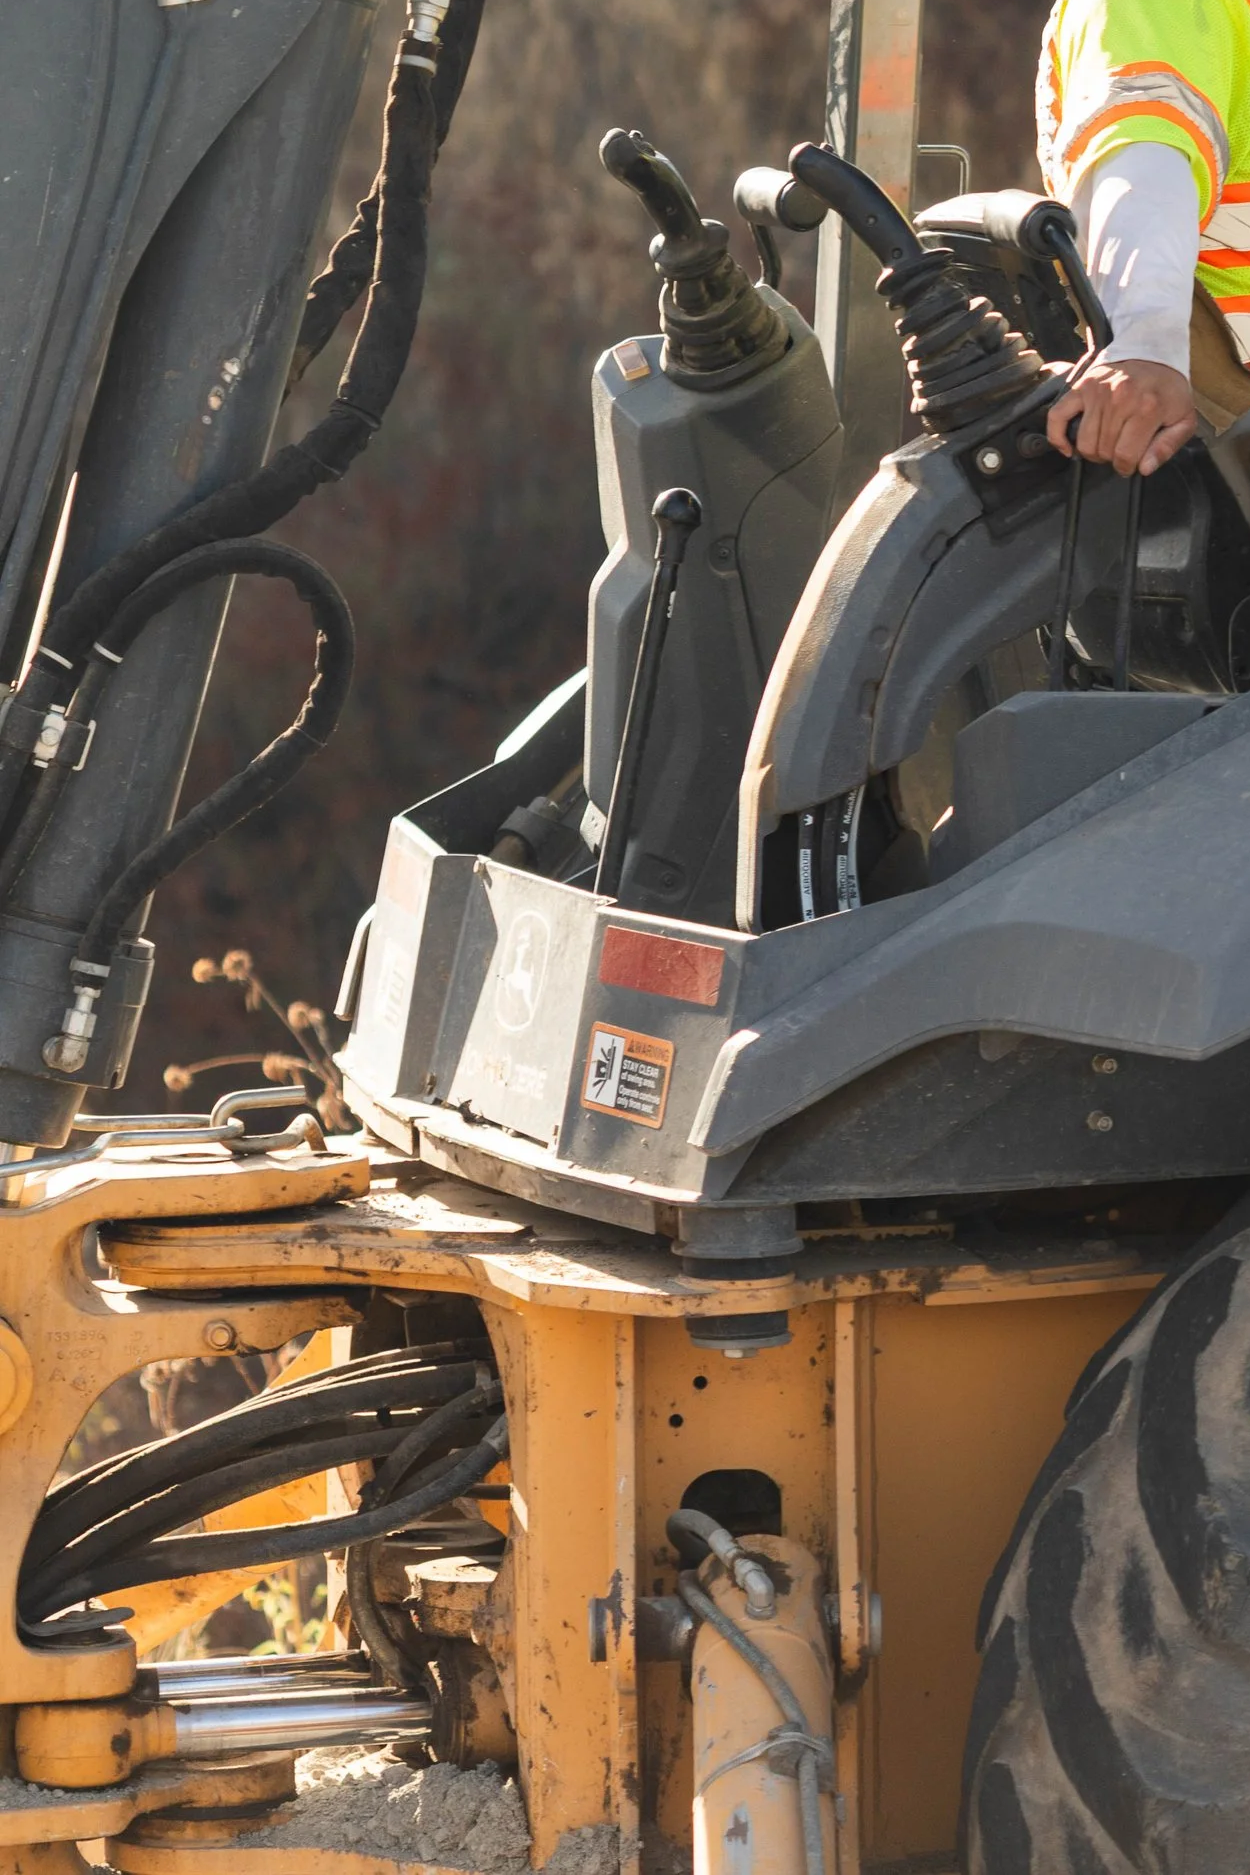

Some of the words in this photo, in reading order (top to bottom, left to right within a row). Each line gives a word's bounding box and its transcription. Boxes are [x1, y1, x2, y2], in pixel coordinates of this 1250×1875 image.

[802, 850, 811, 895] AEROQUIP
[633, 1040, 670, 1062] WARNING
[622, 1059, 639, 1072] STAY
[638, 1064, 660, 1078] CLEAR
[618, 1084, 640, 1098] Operate
[616, 1096, 629, 1109] only
